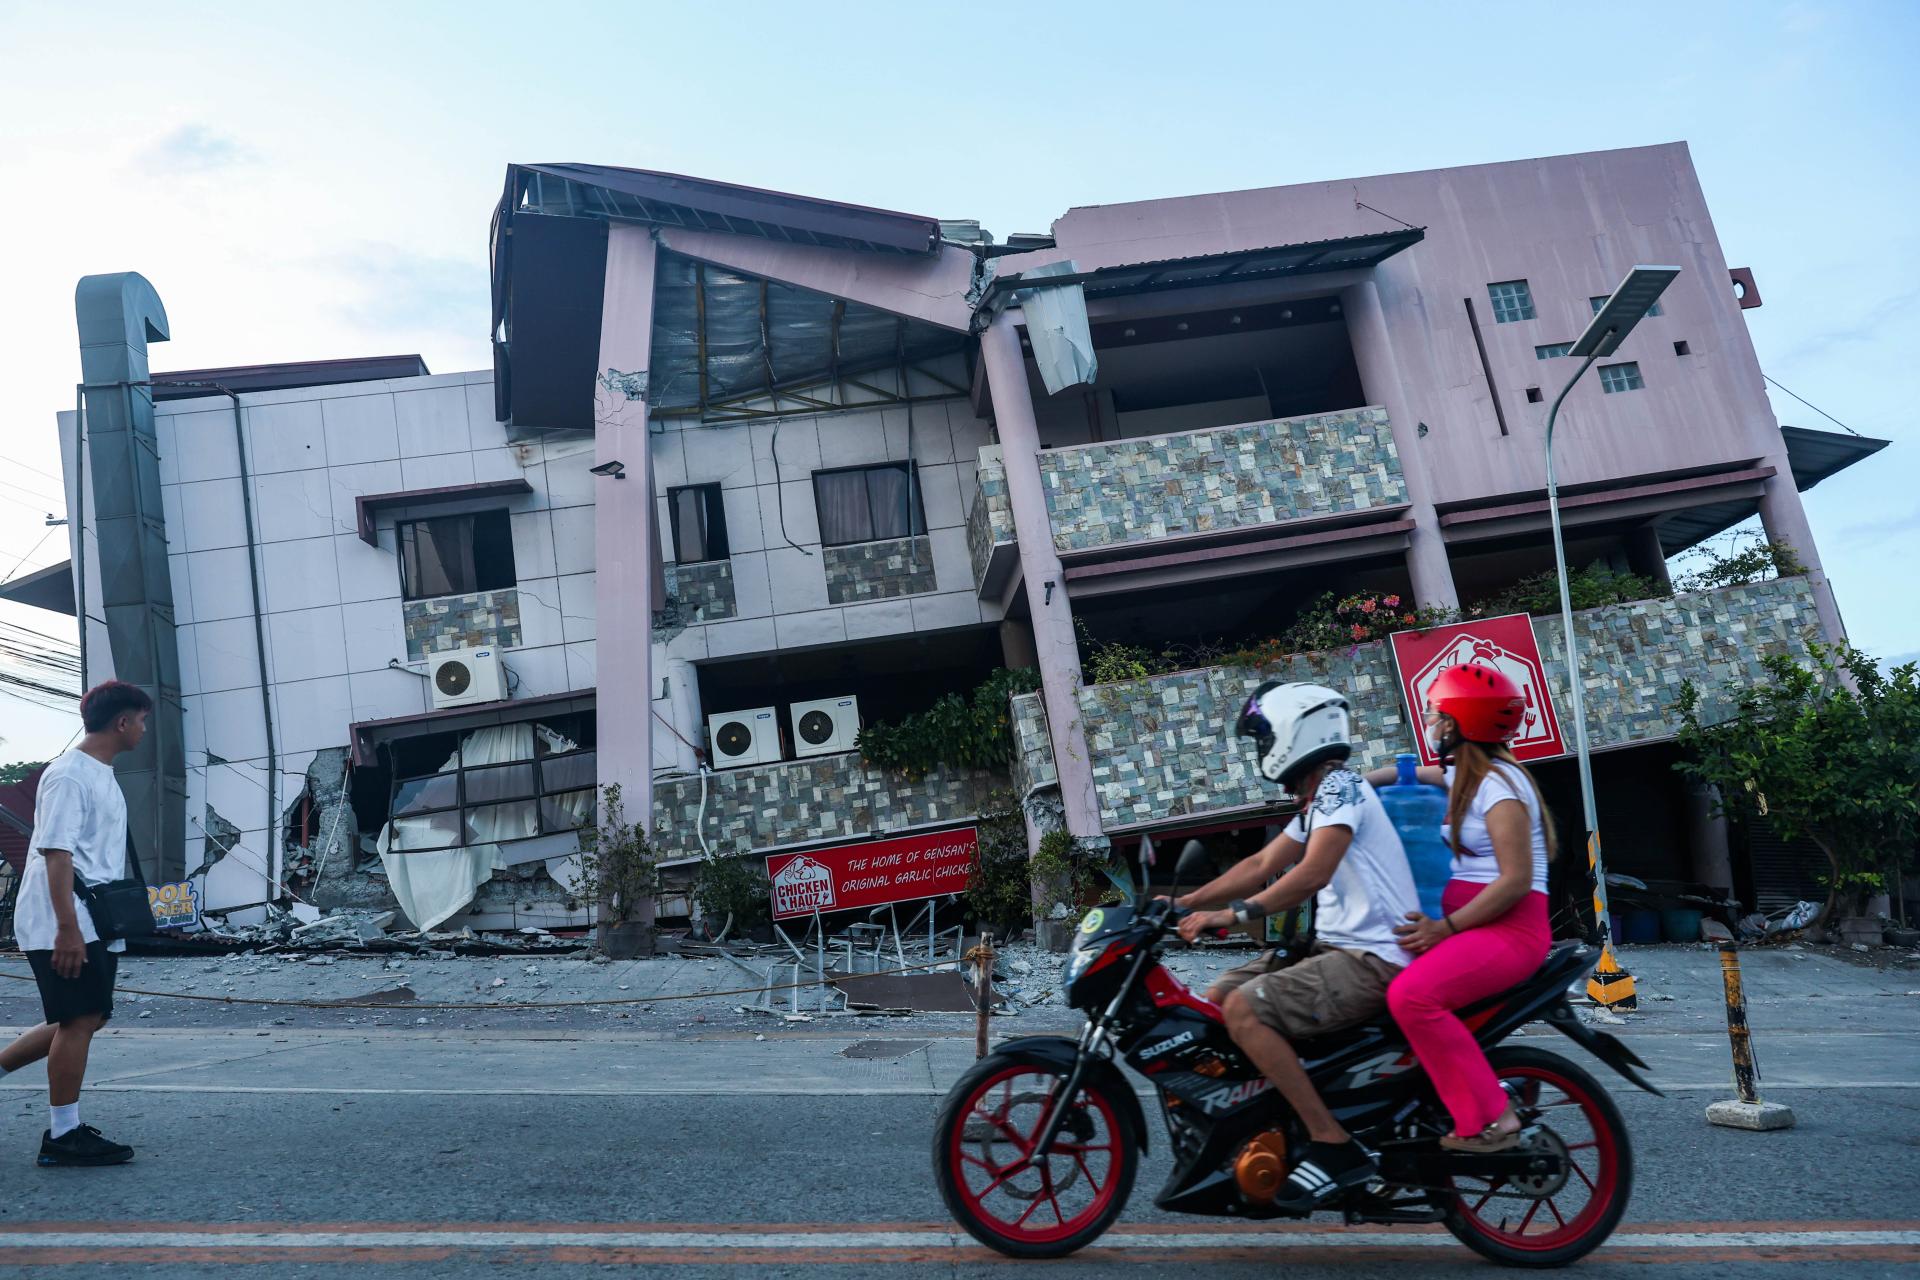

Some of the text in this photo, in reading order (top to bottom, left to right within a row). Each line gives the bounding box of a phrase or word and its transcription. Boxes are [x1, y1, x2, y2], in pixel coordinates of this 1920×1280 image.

[848, 858, 868, 872] THE
[871, 853, 903, 869] HOME
[906, 850, 921, 864] OF
[777, 879, 829, 898] CHICKEN
[841, 862, 974, 893] ORIGINAL GARLIC CHICKE
[789, 893, 821, 909] HAUZ
[1139, 1031, 1194, 1060] SUZUKI
